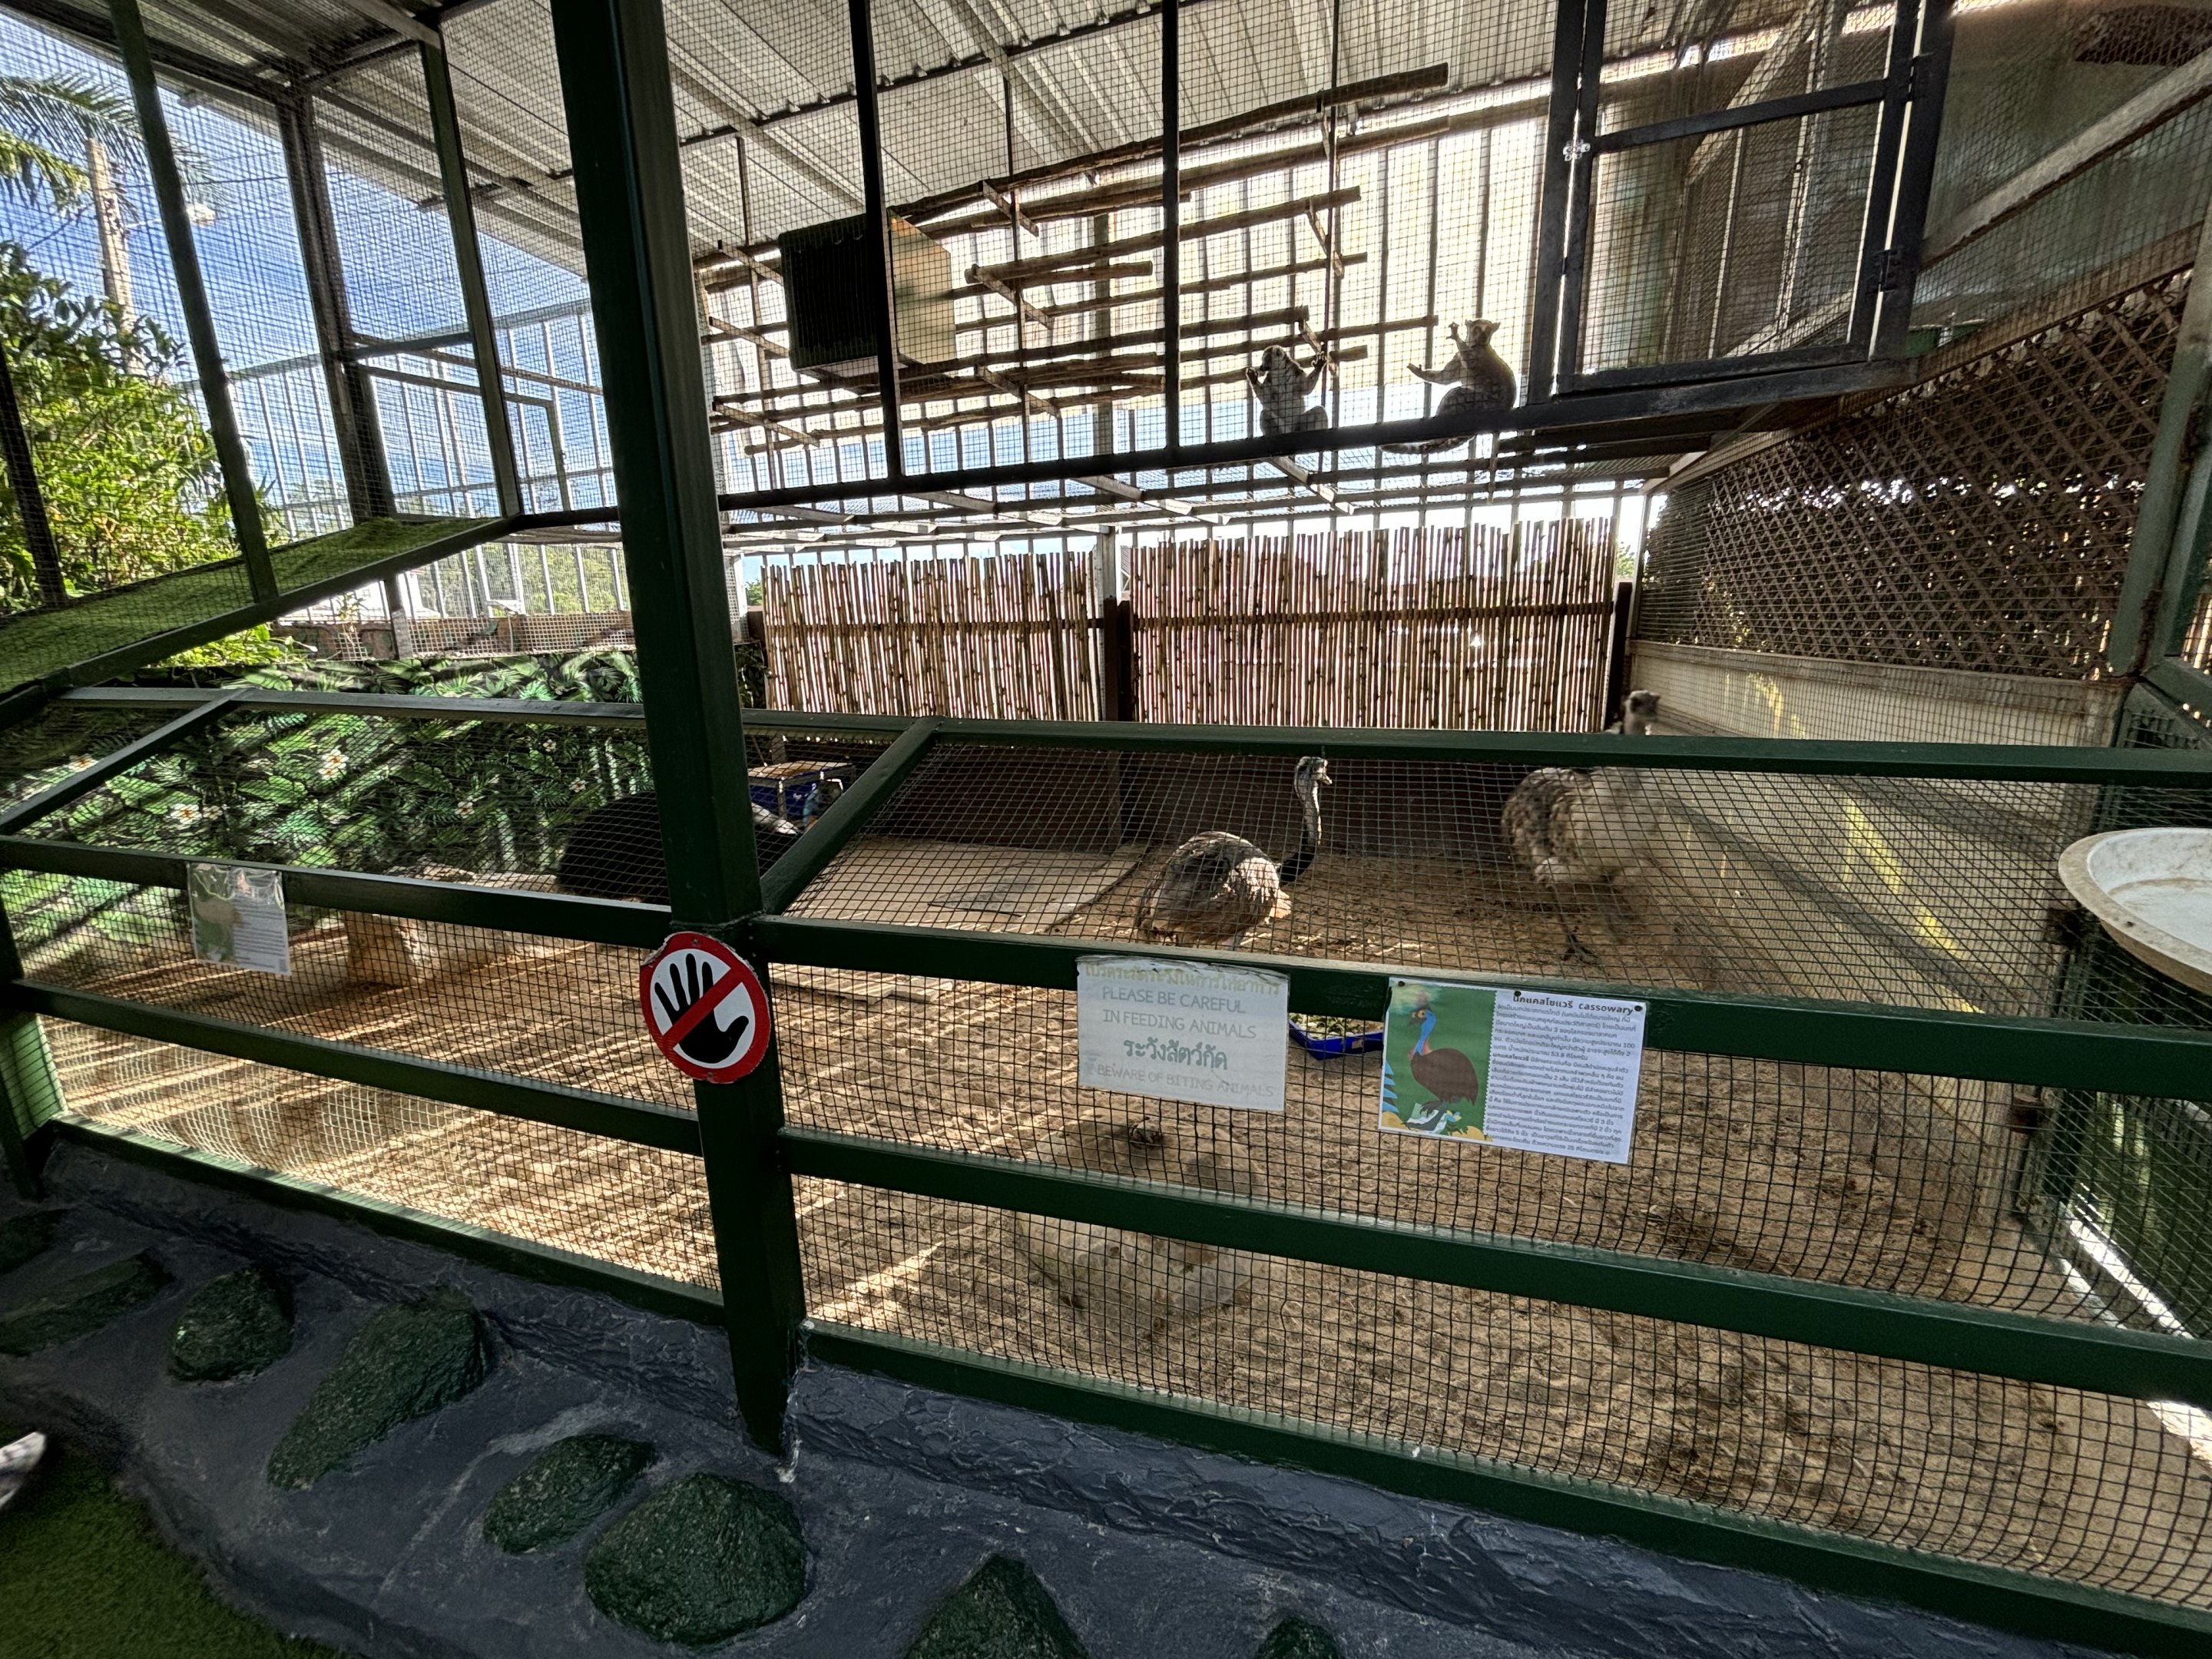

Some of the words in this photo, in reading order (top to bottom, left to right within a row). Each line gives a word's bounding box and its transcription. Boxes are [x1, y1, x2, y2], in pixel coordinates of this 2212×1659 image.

[1102, 986, 1154, 1003] PLEASE
[1157, 992, 1175, 1005] BE
[1180, 994, 1246, 1014] CAREFUL
[1578, 1002, 1634, 1015] cassowary
[1103, 1009, 1120, 1023] IN
[1123, 1011, 1184, 1031] FEEDING
[1189, 1019, 1257, 1038] ANIMALS
[1123, 1036, 1228, 1071] ระวังสัตว์กัด
[1097, 1063, 1144, 1081] BEWARE
[1148, 1072, 1163, 1083] OF
[1166, 1074, 1214, 1091] BITING
[1217, 1080, 1273, 1097] ANIMALS
